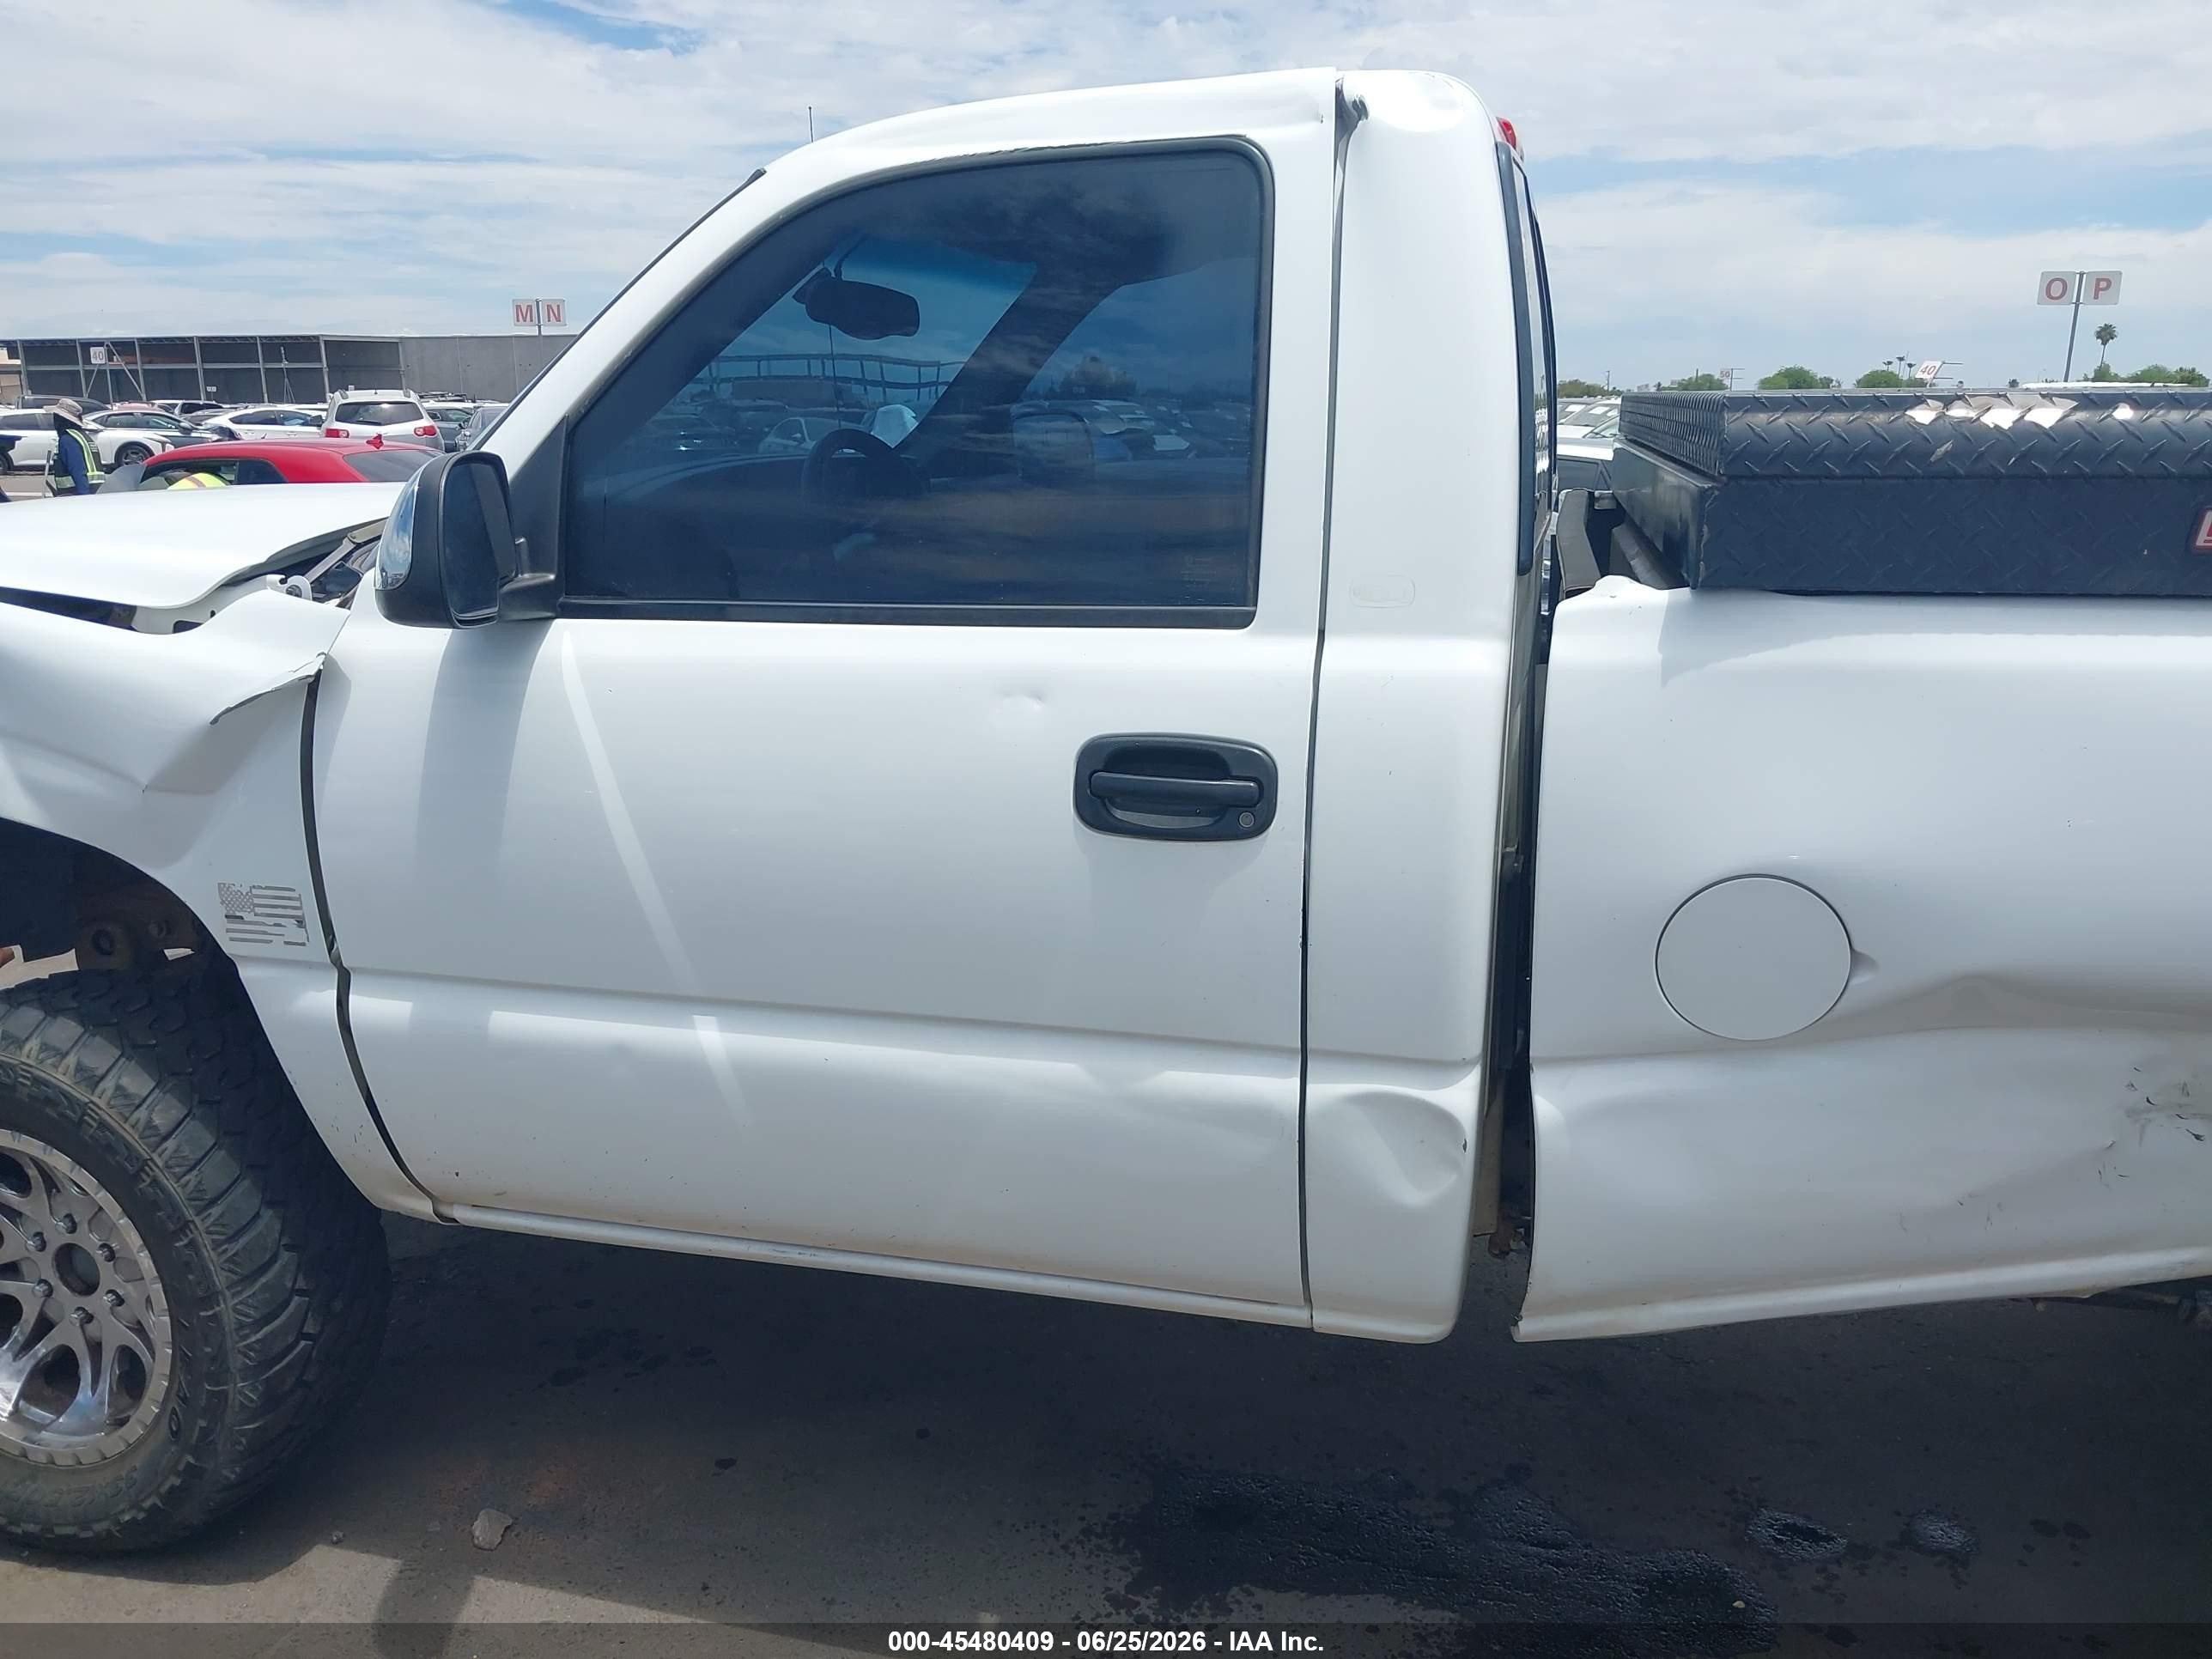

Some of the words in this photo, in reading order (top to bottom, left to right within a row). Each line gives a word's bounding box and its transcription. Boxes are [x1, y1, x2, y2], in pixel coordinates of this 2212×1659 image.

[2045, 277, 2068, 301] O
[2094, 277, 2112, 300] P
[515, 304, 533, 323] M
[546, 304, 562, 323] N
[92, 351, 104, 361] 40
[1919, 365, 1936, 375] 40
